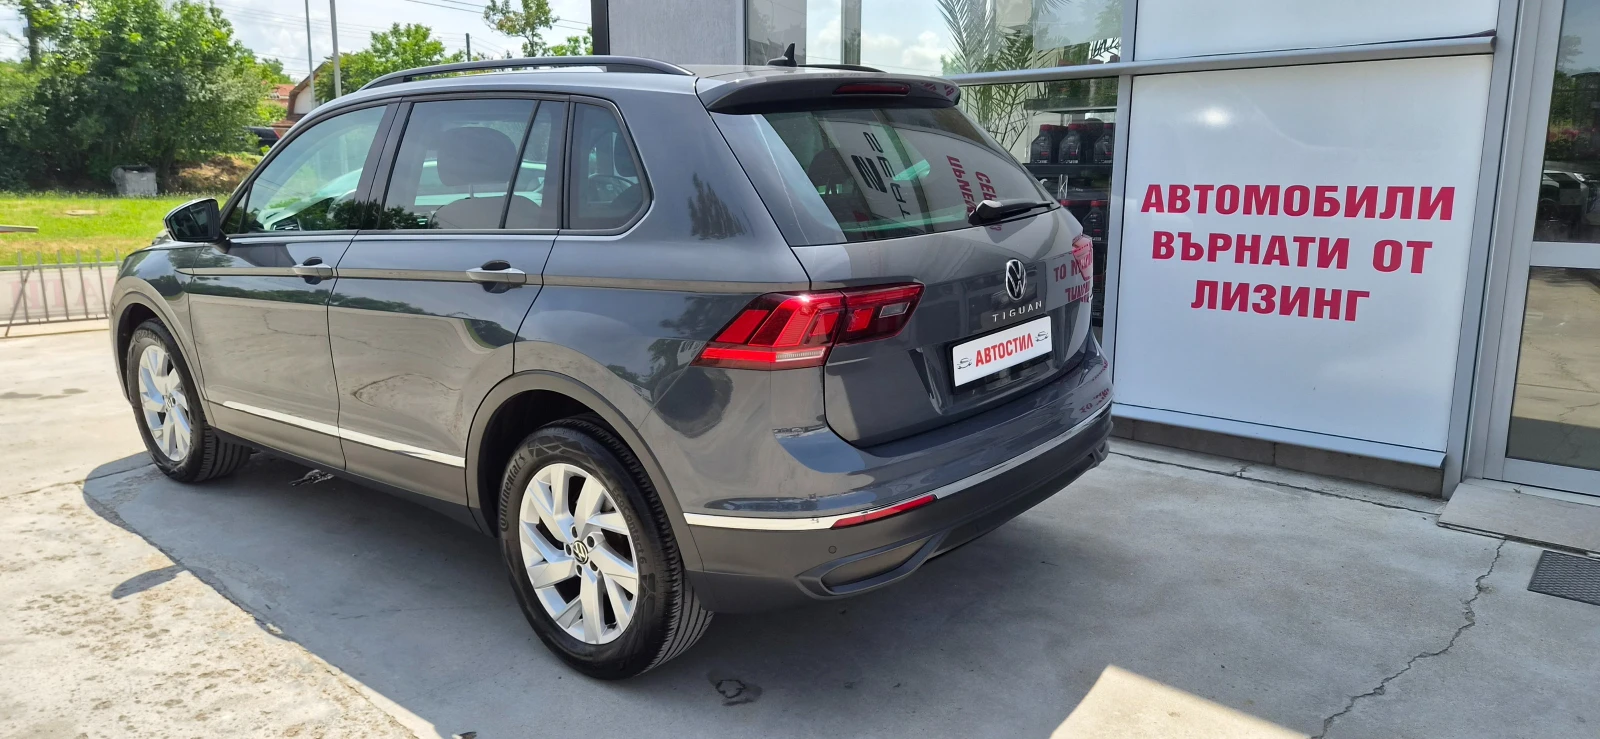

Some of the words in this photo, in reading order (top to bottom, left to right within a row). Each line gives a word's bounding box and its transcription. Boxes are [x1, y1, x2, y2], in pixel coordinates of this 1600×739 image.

[1140, 184, 1455, 221] АВТОМОБИЛИ
[1152, 231, 1350, 270] ВЪРНАТИ
[1372, 239, 1433, 274] ОТ
[992, 300, 1043, 322] TIGUAN
[1190, 279, 1371, 322] ЛИЗИНГ
[975, 333, 1034, 367] АВТОСТИЛ
[500, 458, 522, 532] Continental
